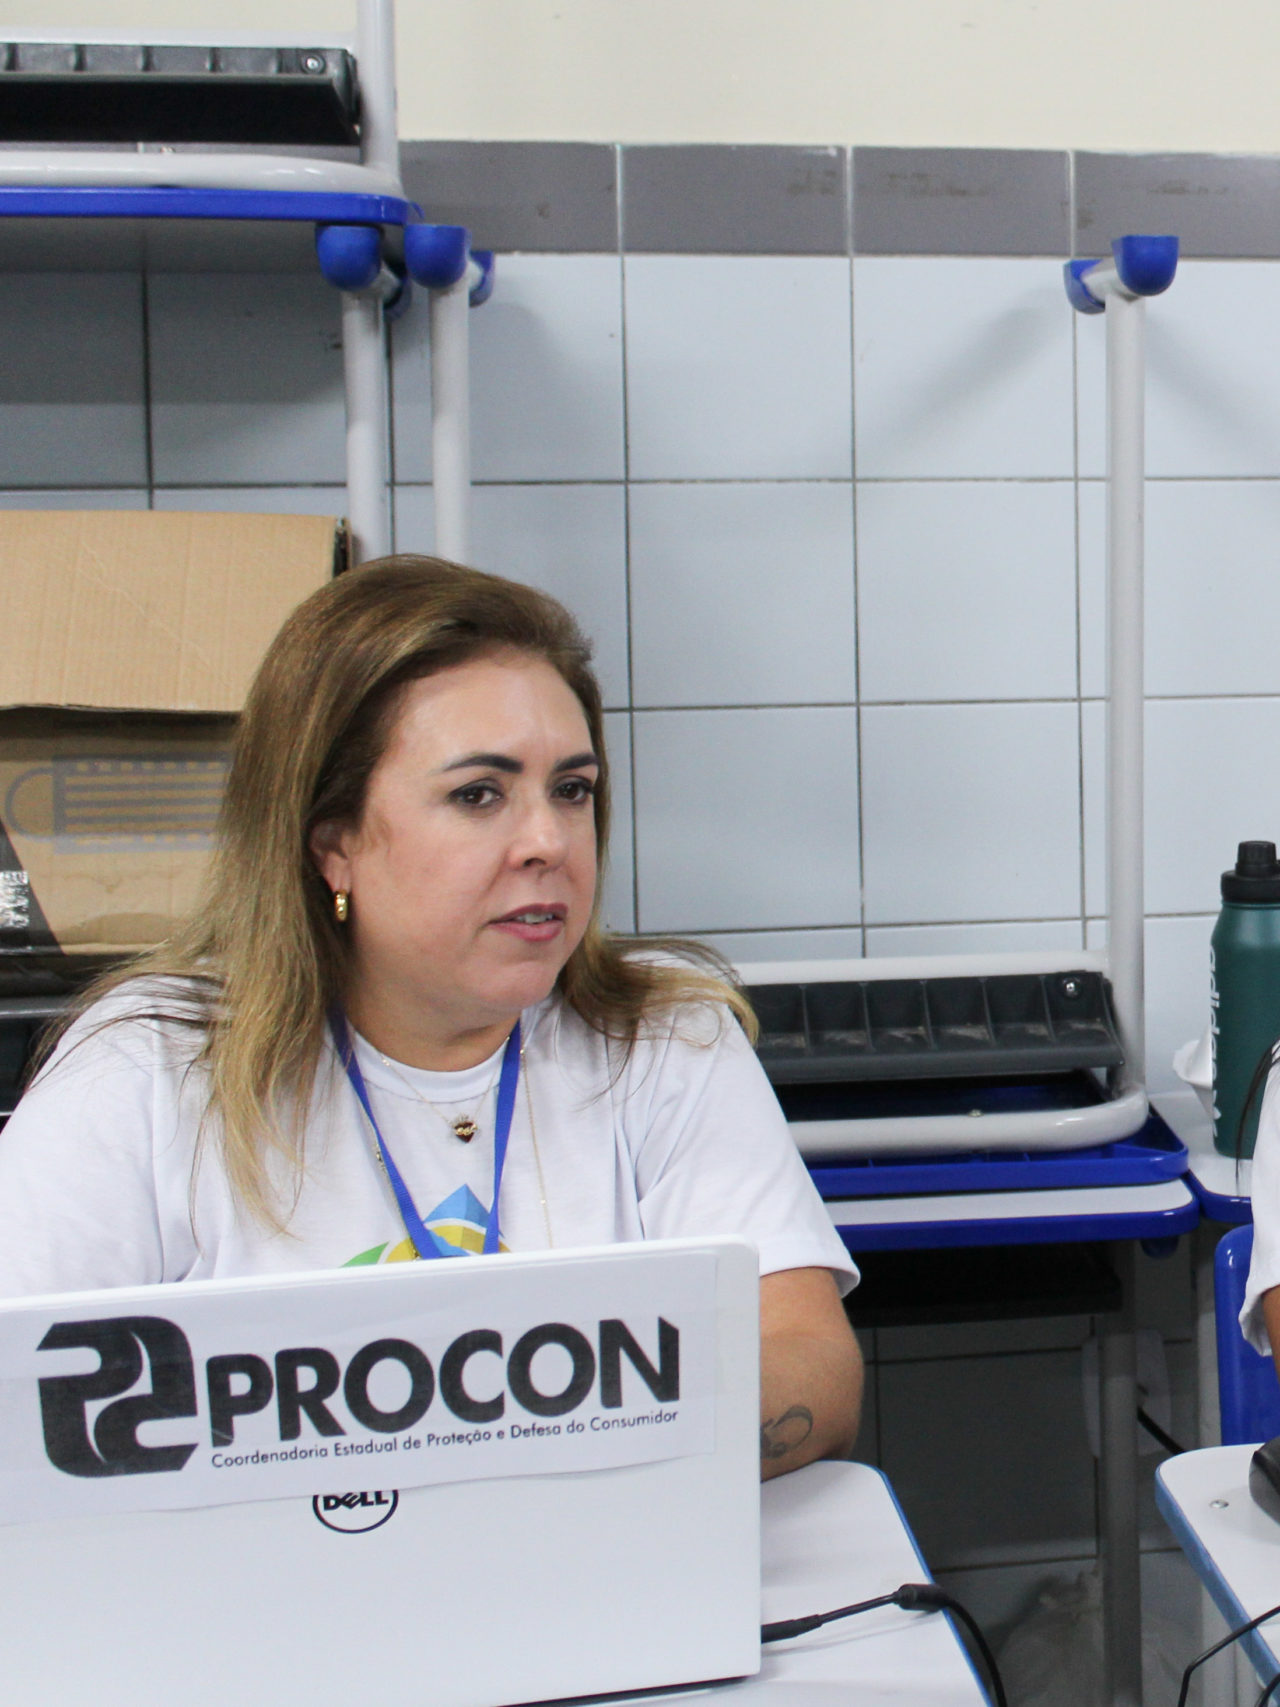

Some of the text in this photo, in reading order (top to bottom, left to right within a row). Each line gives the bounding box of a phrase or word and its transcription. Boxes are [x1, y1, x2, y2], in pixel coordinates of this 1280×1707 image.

[206, 1316, 679, 1447] PROCON
[211, 1410, 679, 1468] Coordenadoria Estadual de Proteção e Defesa do Consumidor
[323, 1490, 389, 1511] DELL
